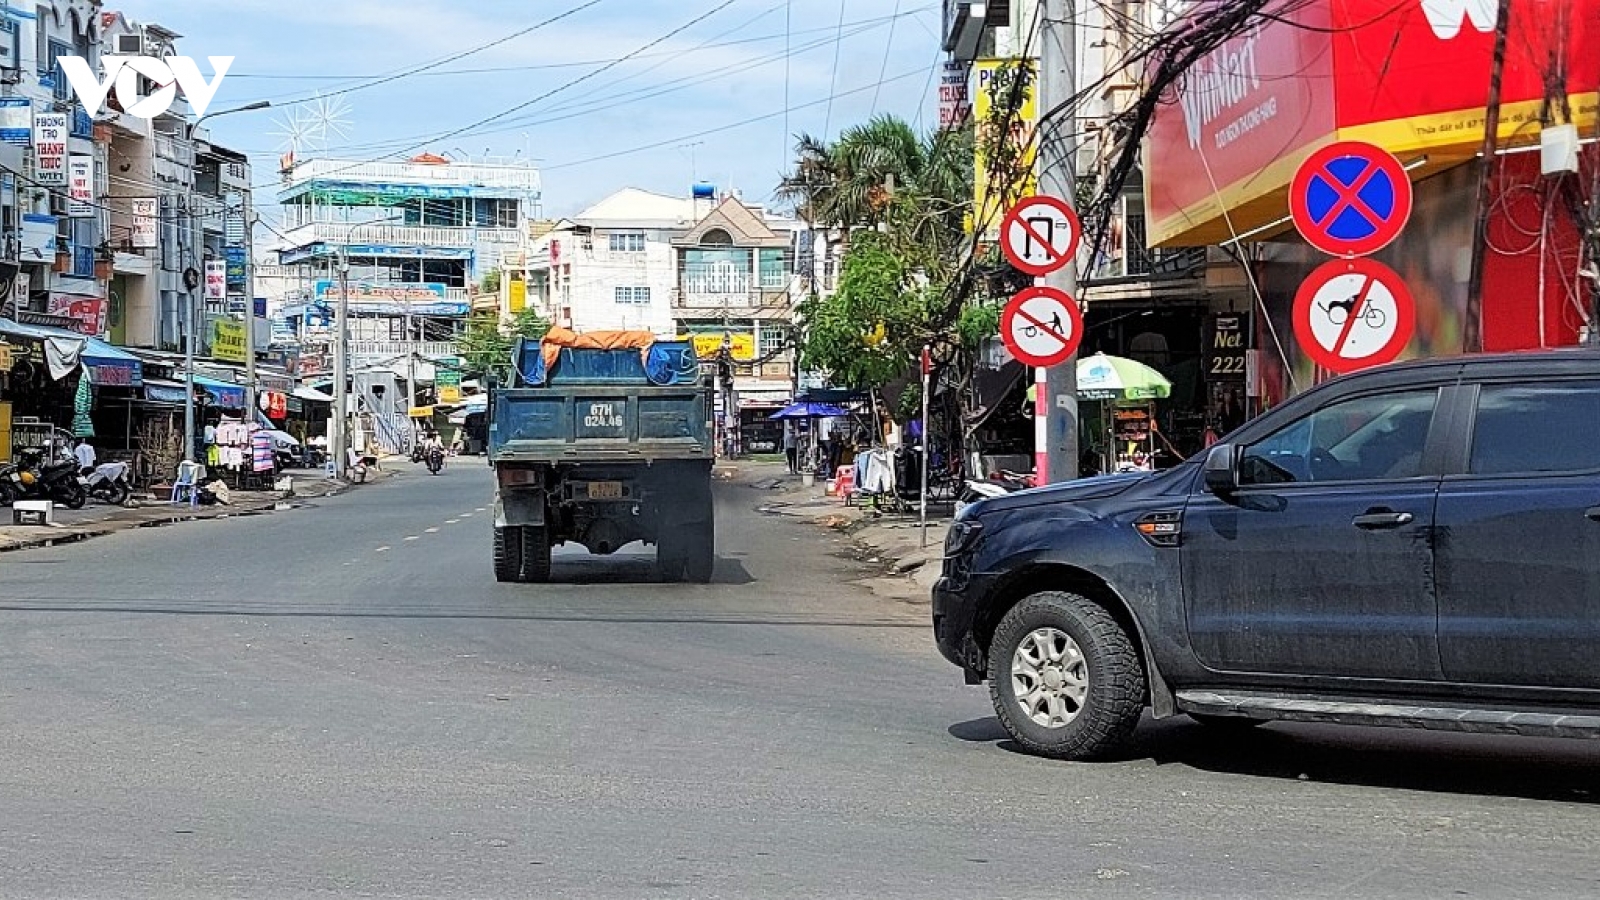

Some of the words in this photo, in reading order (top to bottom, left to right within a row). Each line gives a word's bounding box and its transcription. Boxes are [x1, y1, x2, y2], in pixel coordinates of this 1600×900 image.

[1214, 331, 1243, 348] Net
[1210, 356, 1244, 374] 222
[590, 403, 612, 416] 67H
[584, 414, 623, 427] 024.46
